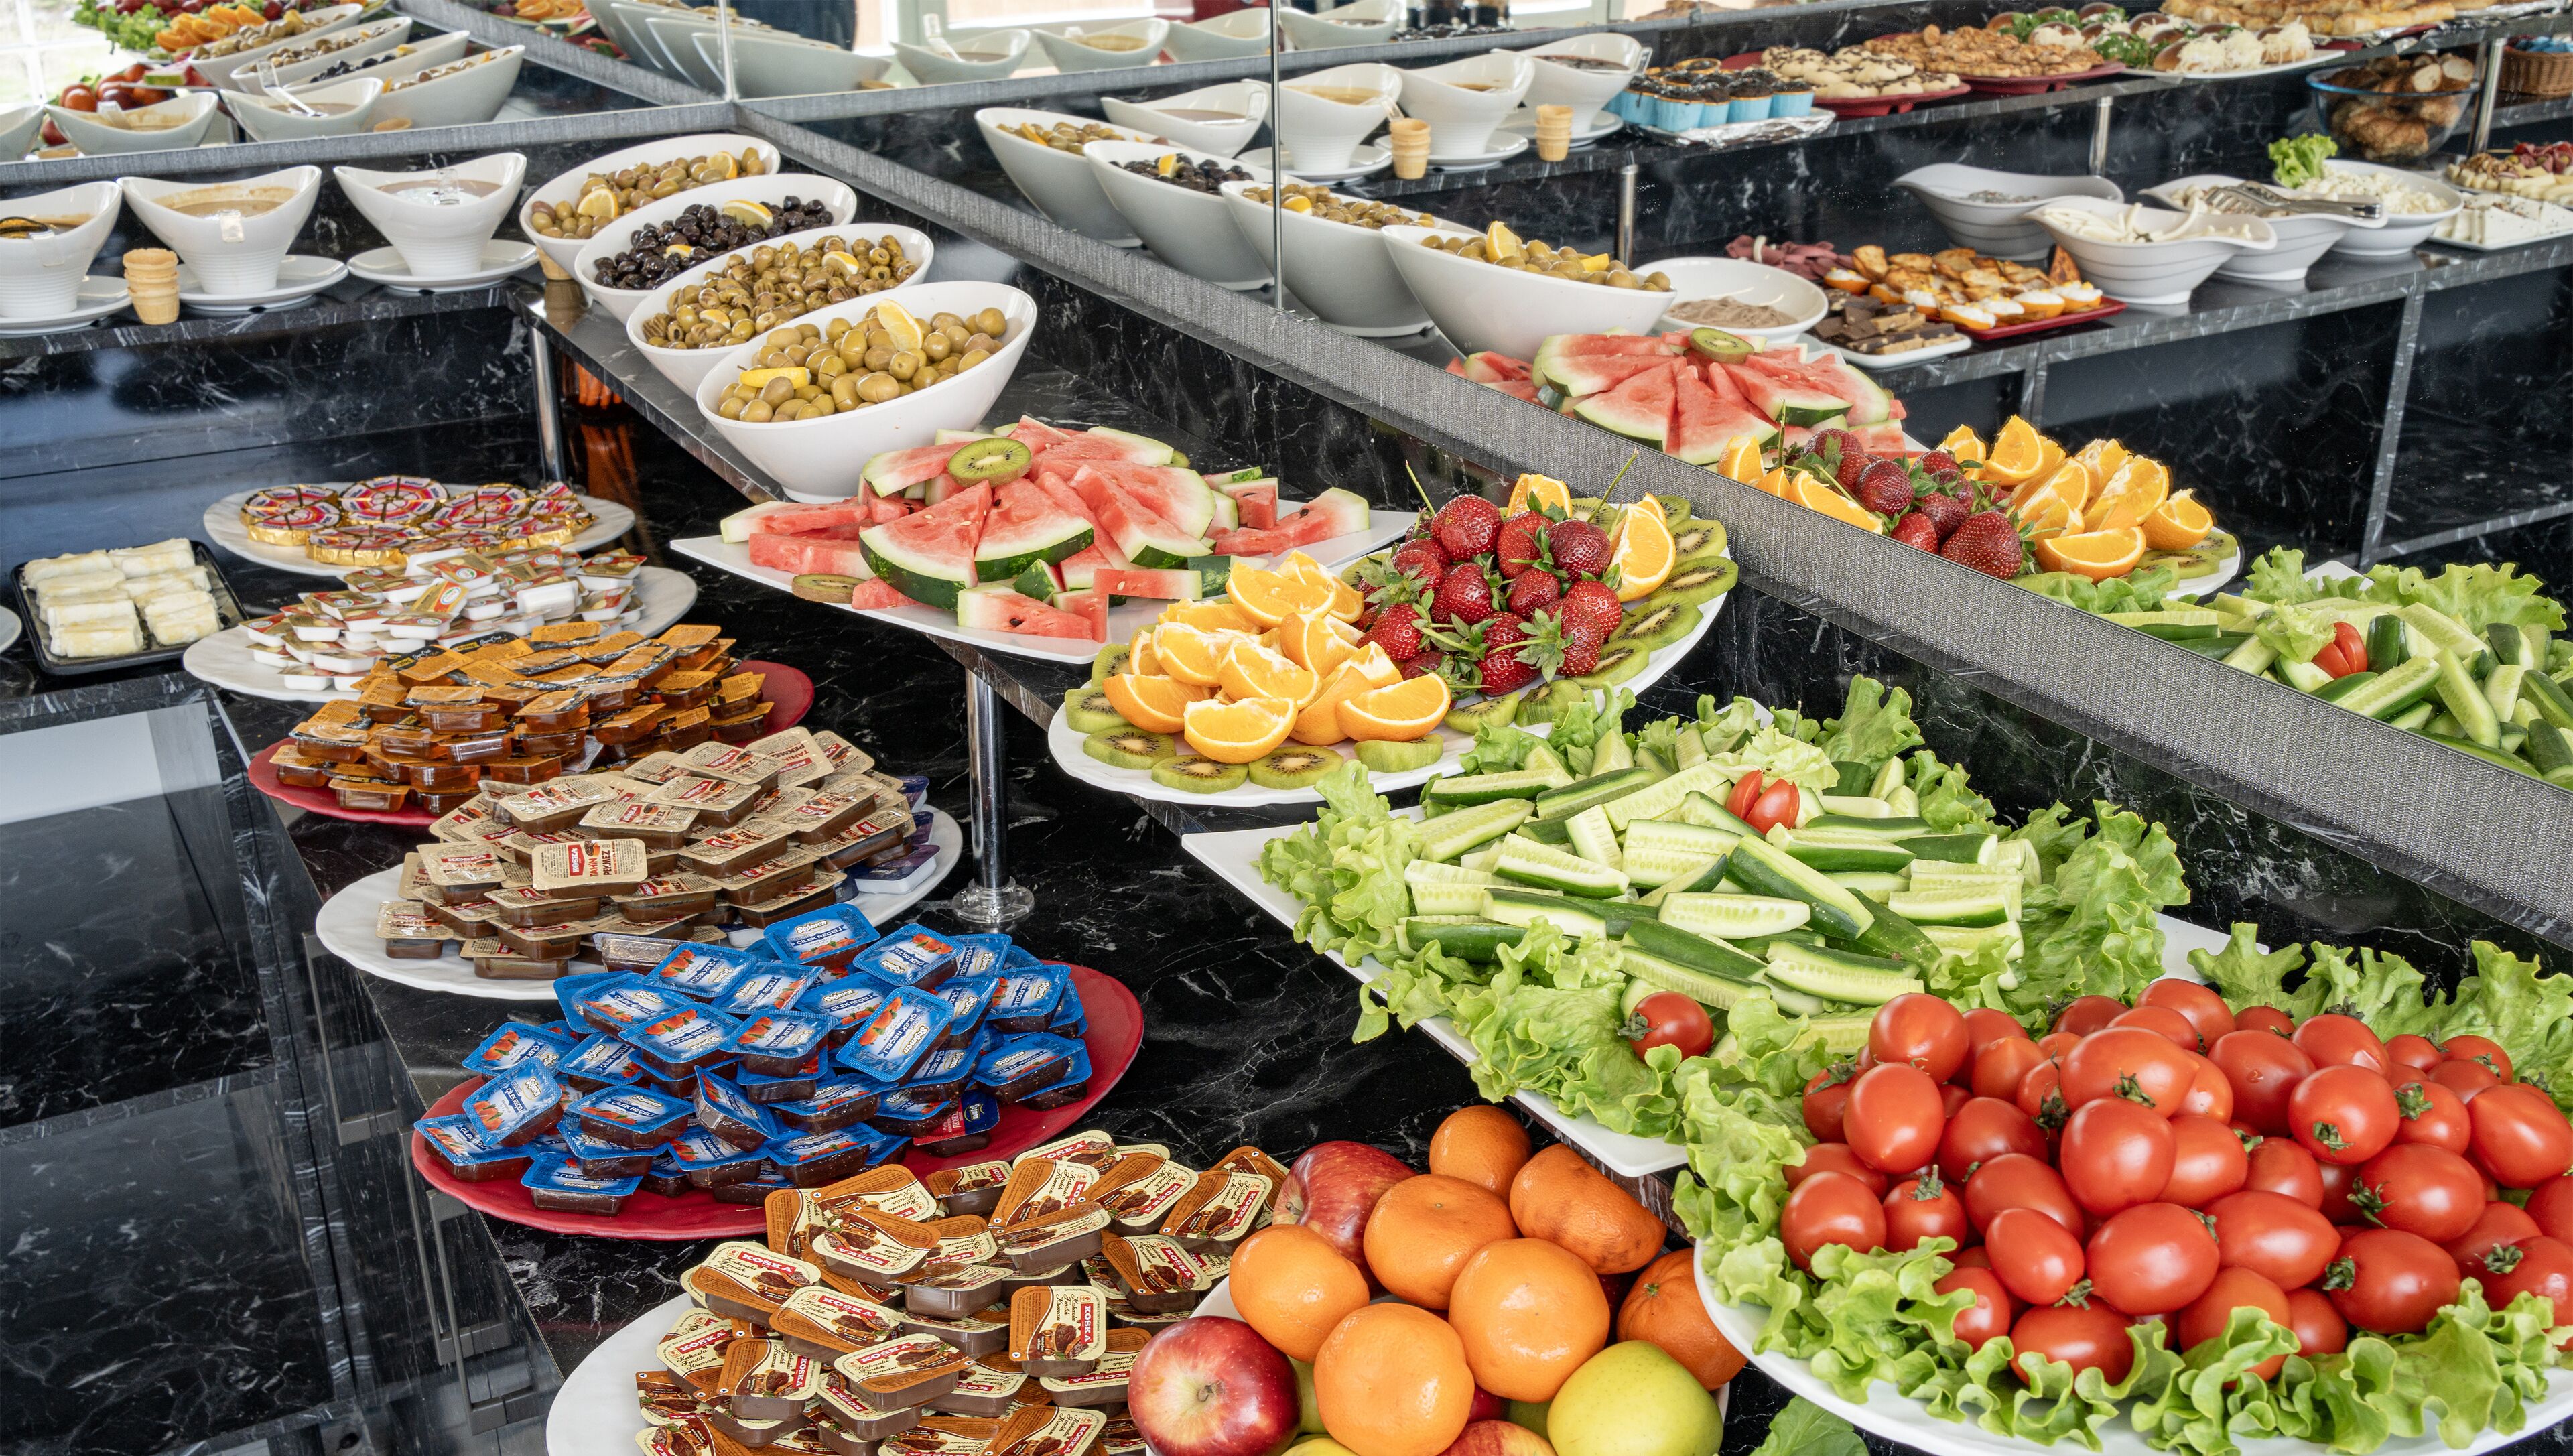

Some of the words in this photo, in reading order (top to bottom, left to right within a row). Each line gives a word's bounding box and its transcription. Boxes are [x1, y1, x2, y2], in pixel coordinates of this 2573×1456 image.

[590, 858, 599, 877] TAHİN
[602, 850, 612, 876] PEKMEZ
[902, 1013, 917, 1035] ÇİLEK
[883, 1033, 903, 1057] REÇELİ
[1144, 1184, 1180, 1213] KOSKA
[1231, 1192, 1257, 1227] KOSKA
[742, 1254, 793, 1272] KOSKA
[838, 1248, 885, 1264] KOSKA
[1165, 1249, 1191, 1278] KOSKA
[821, 1297, 874, 1317] KOSKA
[679, 1331, 726, 1352] KOSKA
[860, 1344, 911, 1362] KOSKA
[795, 1358, 809, 1387] KOSKA
[1071, 1373, 1128, 1383] KOSKA
[832, 1387, 864, 1411] KOSKA
[1063, 1425, 1089, 1454] KOSKA
